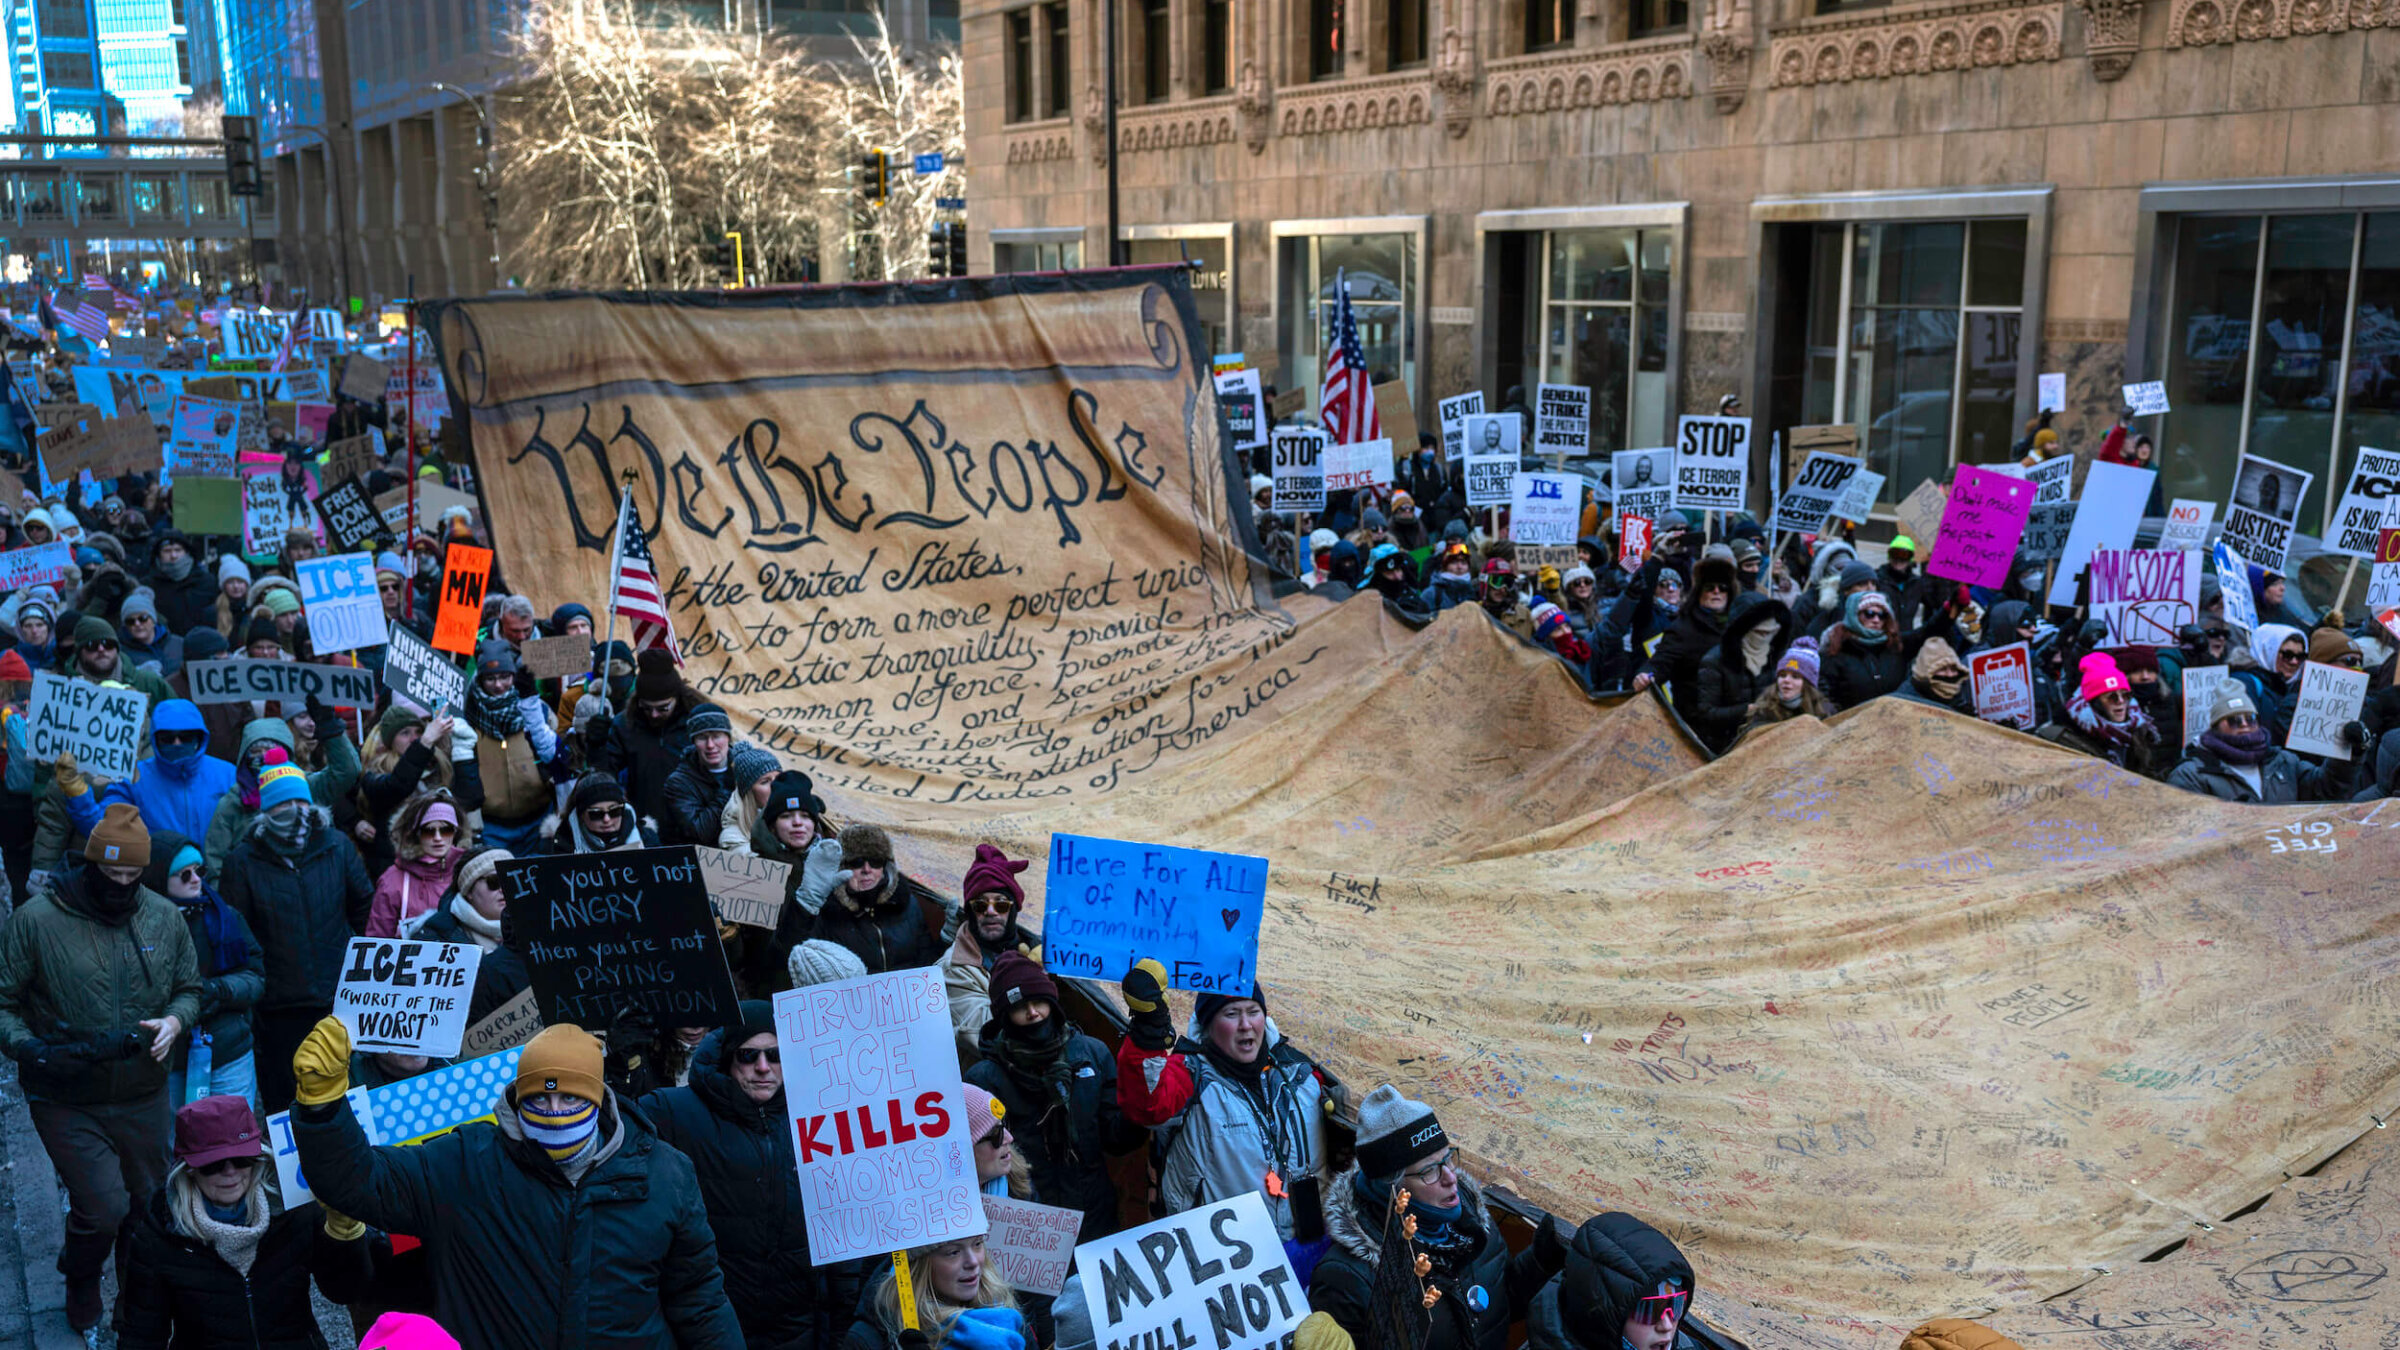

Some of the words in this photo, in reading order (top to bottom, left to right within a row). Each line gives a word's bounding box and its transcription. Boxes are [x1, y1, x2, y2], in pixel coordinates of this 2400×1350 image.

[1442, 401, 1459, 421] ICE
[1460, 396, 1480, 416] OUT
[1541, 388, 1588, 403] GENERAL
[1539, 432, 1587, 447] JUSTICE
[1540, 418, 1554, 432] THE
[1555, 419, 1576, 432] PATH
[1577, 420, 1588, 432] TO
[1683, 421, 1746, 458] STOP
[1276, 436, 1323, 467] STOP
[508, 402, 735, 555] We
[717, 418, 873, 552] the
[852, 389, 1165, 548] People
[1275, 477, 1287, 491] ICE
[1289, 476, 1323, 491] TERROR
[1326, 474, 1353, 490] STOP
[1353, 469, 1374, 485] ICE
[1469, 462, 1502, 477] JUSTICE
[1503, 461, 1518, 476] FOR
[1470, 477, 1488, 492] ALEX
[1679, 467, 1696, 484] ICE
[1698, 468, 1742, 485] TERROR
[1799, 457, 1857, 491] STOP
[322, 482, 360, 515] FREE
[1275, 490, 1322, 501] NOW!
[1526, 478, 1563, 499] ICE
[1617, 492, 1652, 506] JUSTICE
[1653, 490, 1671, 504] FOR
[1678, 484, 1740, 498] NOW!
[1780, 495, 1798, 511] ICE
[1798, 497, 1834, 513] TERROR
[331, 501, 370, 534] DON
[1778, 508, 1825, 523] NOW!
[2030, 510, 2047, 524] WE
[2172, 506, 2200, 522] NO
[2225, 508, 2290, 551] JUSTICE
[340, 516, 380, 549] LEMON
[2029, 530, 2047, 551] US
[1518, 548, 1542, 564] ICE
[2250, 546, 2284, 571] GOOD
[301, 558, 376, 602] ICE
[447, 570, 484, 608] MN
[679, 561, 755, 612] the
[758, 548, 879, 603] United
[883, 537, 1024, 591] States,
[309, 602, 383, 650] OUT
[745, 612, 793, 653] to
[785, 606, 882, 662] form
[1000, 561, 1123, 638] perfect
[393, 627, 465, 693] IMMIGRANTS
[697, 652, 852, 696] domestic
[1060, 598, 1183, 661] provide
[1054, 632, 1185, 690] promote
[196, 663, 241, 695] ICE
[248, 665, 323, 697] GTFO
[332, 674, 373, 702] MN
[388, 645, 418, 675] MAKE
[421, 670, 465, 711] AMERICA
[961, 693, 1025, 730] and
[1045, 656, 1165, 709] secure
[2307, 668, 2333, 691] MN
[2335, 677, 2359, 697] nice
[48, 680, 99, 711] THEY
[101, 692, 139, 723] ARE
[1173, 674, 1239, 735] for
[2302, 694, 2325, 711] and
[38, 703, 80, 734] ALL
[87, 719, 134, 748] OUR
[1089, 758, 1131, 793] of
[1127, 667, 1301, 773] America
[2296, 714, 2332, 742] FUCK
[34, 729, 134, 774] CHILDREN
[1030, 727, 1072, 758] do
[507, 865, 540, 899] If
[560, 861, 639, 903] you're
[652, 856, 698, 884] not
[1056, 840, 1127, 878] Here
[1141, 852, 1188, 886] For
[1205, 860, 1255, 894] ALL
[1085, 882, 1115, 908] of
[1329, 872, 1383, 901] Fuck
[551, 890, 645, 931] ANGRY
[1055, 903, 1199, 959] Community
[345, 942, 422, 987] ICE
[530, 942, 577, 964] then
[588, 932, 656, 968] you're
[670, 929, 707, 952] not
[422, 966, 466, 987] THE
[574, 960, 676, 990] PAYING
[1171, 959, 1245, 994] Fear!
[406, 996, 424, 1009] OF
[429, 997, 455, 1013] THE
[555, 988, 718, 1021] ATTENTION
[1982, 982, 2054, 1011] POWER
[2002, 988, 2090, 1027] PEOPLE
[1610, 1038, 1634, 1055] NO
[812, 1028, 917, 1110] ICE
[797, 1090, 951, 1164] KILLS
[811, 1142, 942, 1210] MOMS
[810, 1184, 973, 1259] NURSES
[1004, 1225, 1062, 1251] HEAR
[1000, 1252, 1067, 1292] VOICE
[1099, 1208, 1254, 1328] MPLS
[1205, 1264, 1294, 1350] NOT
